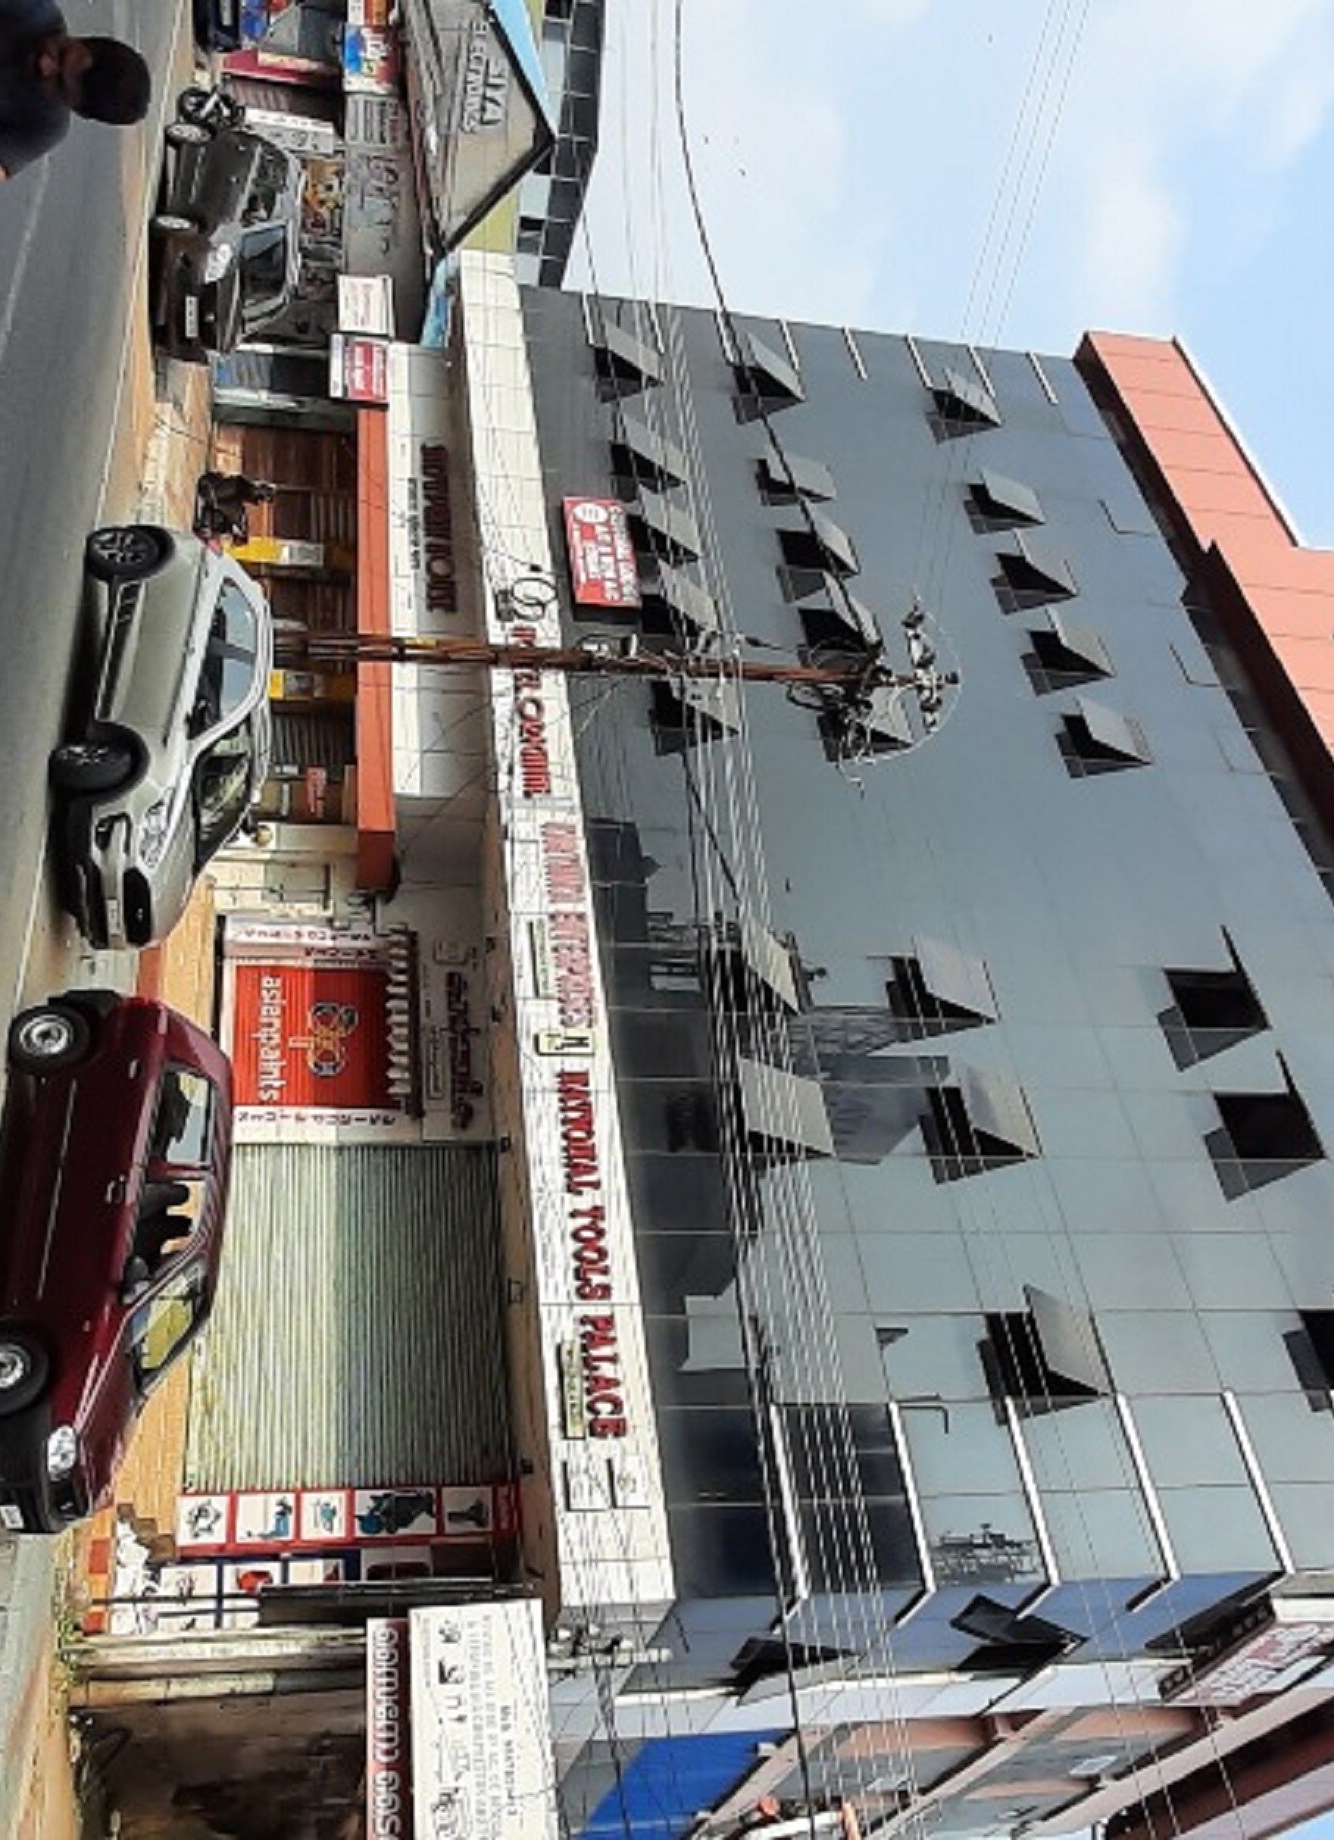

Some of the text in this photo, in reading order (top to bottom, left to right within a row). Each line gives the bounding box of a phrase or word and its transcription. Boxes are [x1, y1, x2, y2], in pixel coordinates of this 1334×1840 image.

[480, 57, 508, 126] SIYA
[548, 912, 598, 1029] ENTERPRISES
[250, 976, 287, 1100] asianpaints
[556, 1069, 601, 1196] NATIONAL
[570, 1205, 613, 1301] TOOLS
[579, 1314, 628, 1439] PALACE
